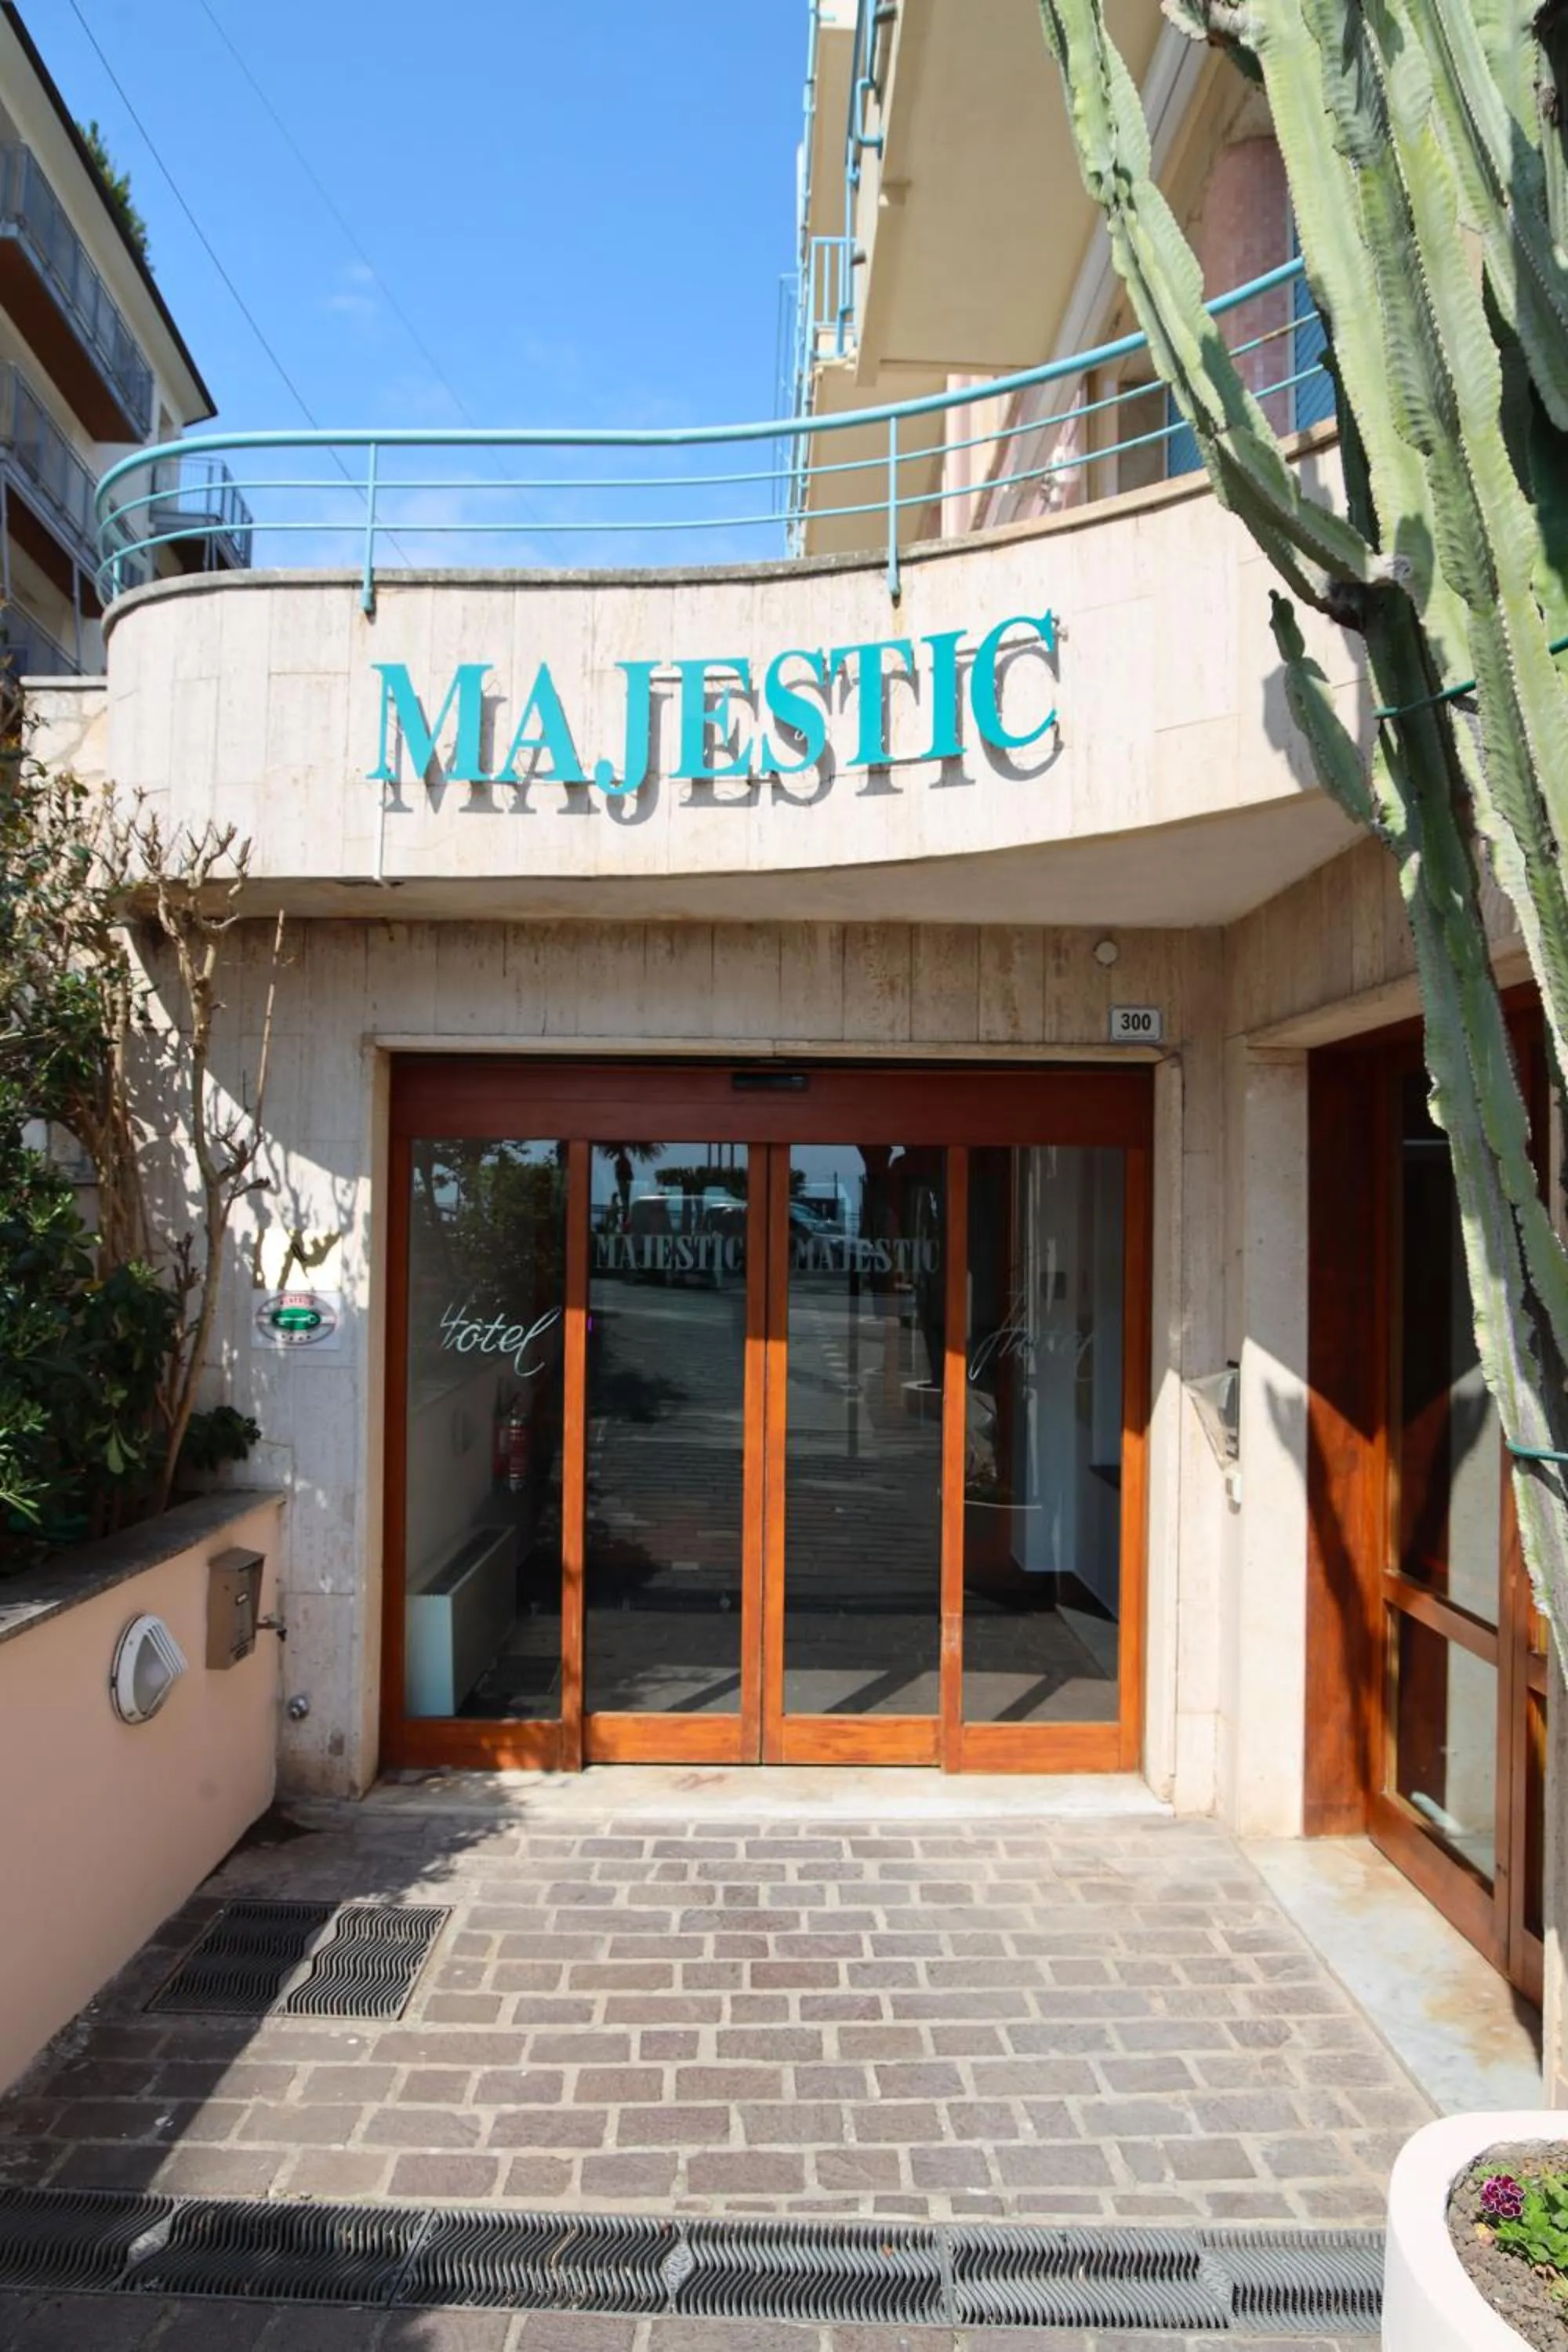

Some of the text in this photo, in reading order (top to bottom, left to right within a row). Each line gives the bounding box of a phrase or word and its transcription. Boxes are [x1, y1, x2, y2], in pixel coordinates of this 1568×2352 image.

[366, 608, 1060, 796] MAJESTIC
[1120, 1013, 1152, 1031] 300
[595, 1233, 744, 1271] MAJESTIC
[795, 1237, 941, 1273] MAJESTIC
